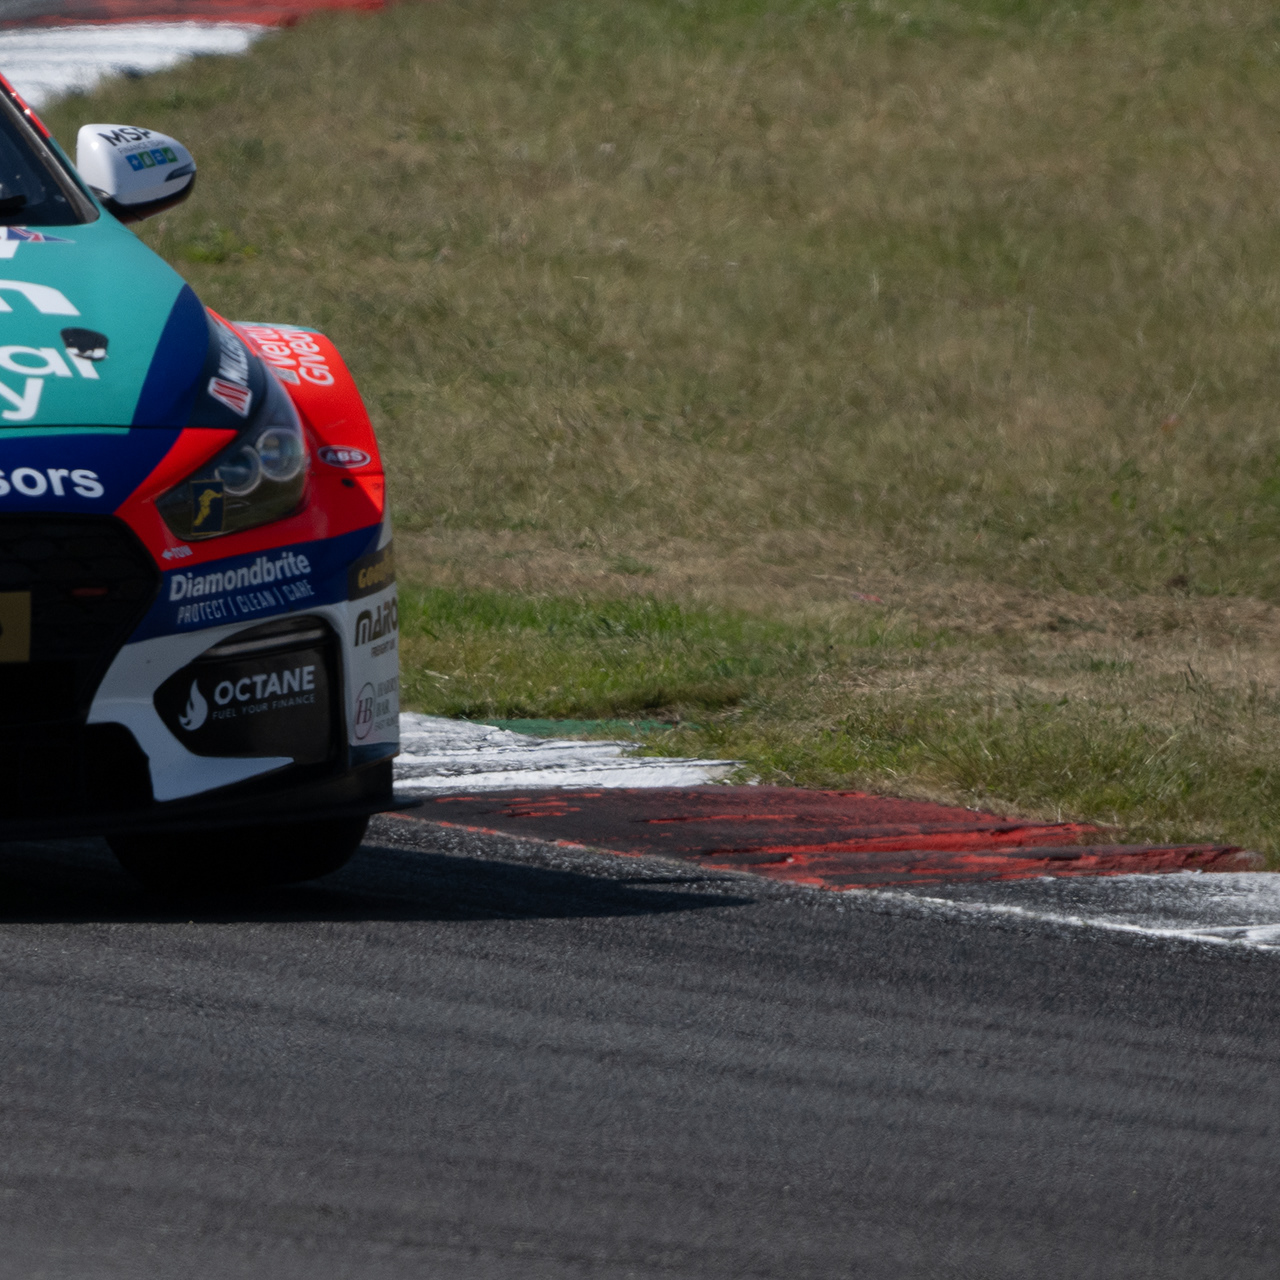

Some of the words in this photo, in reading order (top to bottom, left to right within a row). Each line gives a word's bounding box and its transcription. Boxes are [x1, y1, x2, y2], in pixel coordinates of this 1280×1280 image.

[325, 451, 362, 462] ABS
[169, 552, 312, 601] Diamondbrite
[177, 598, 227, 625] PROTECT
[239, 591, 277, 614] CLEAN
[288, 580, 316, 601] CARE
[213, 665, 316, 705] OCTANE
[212, 707, 237, 720] FUEL
[241, 702, 271, 716] YOUR
[272, 693, 316, 710] FINANCE
